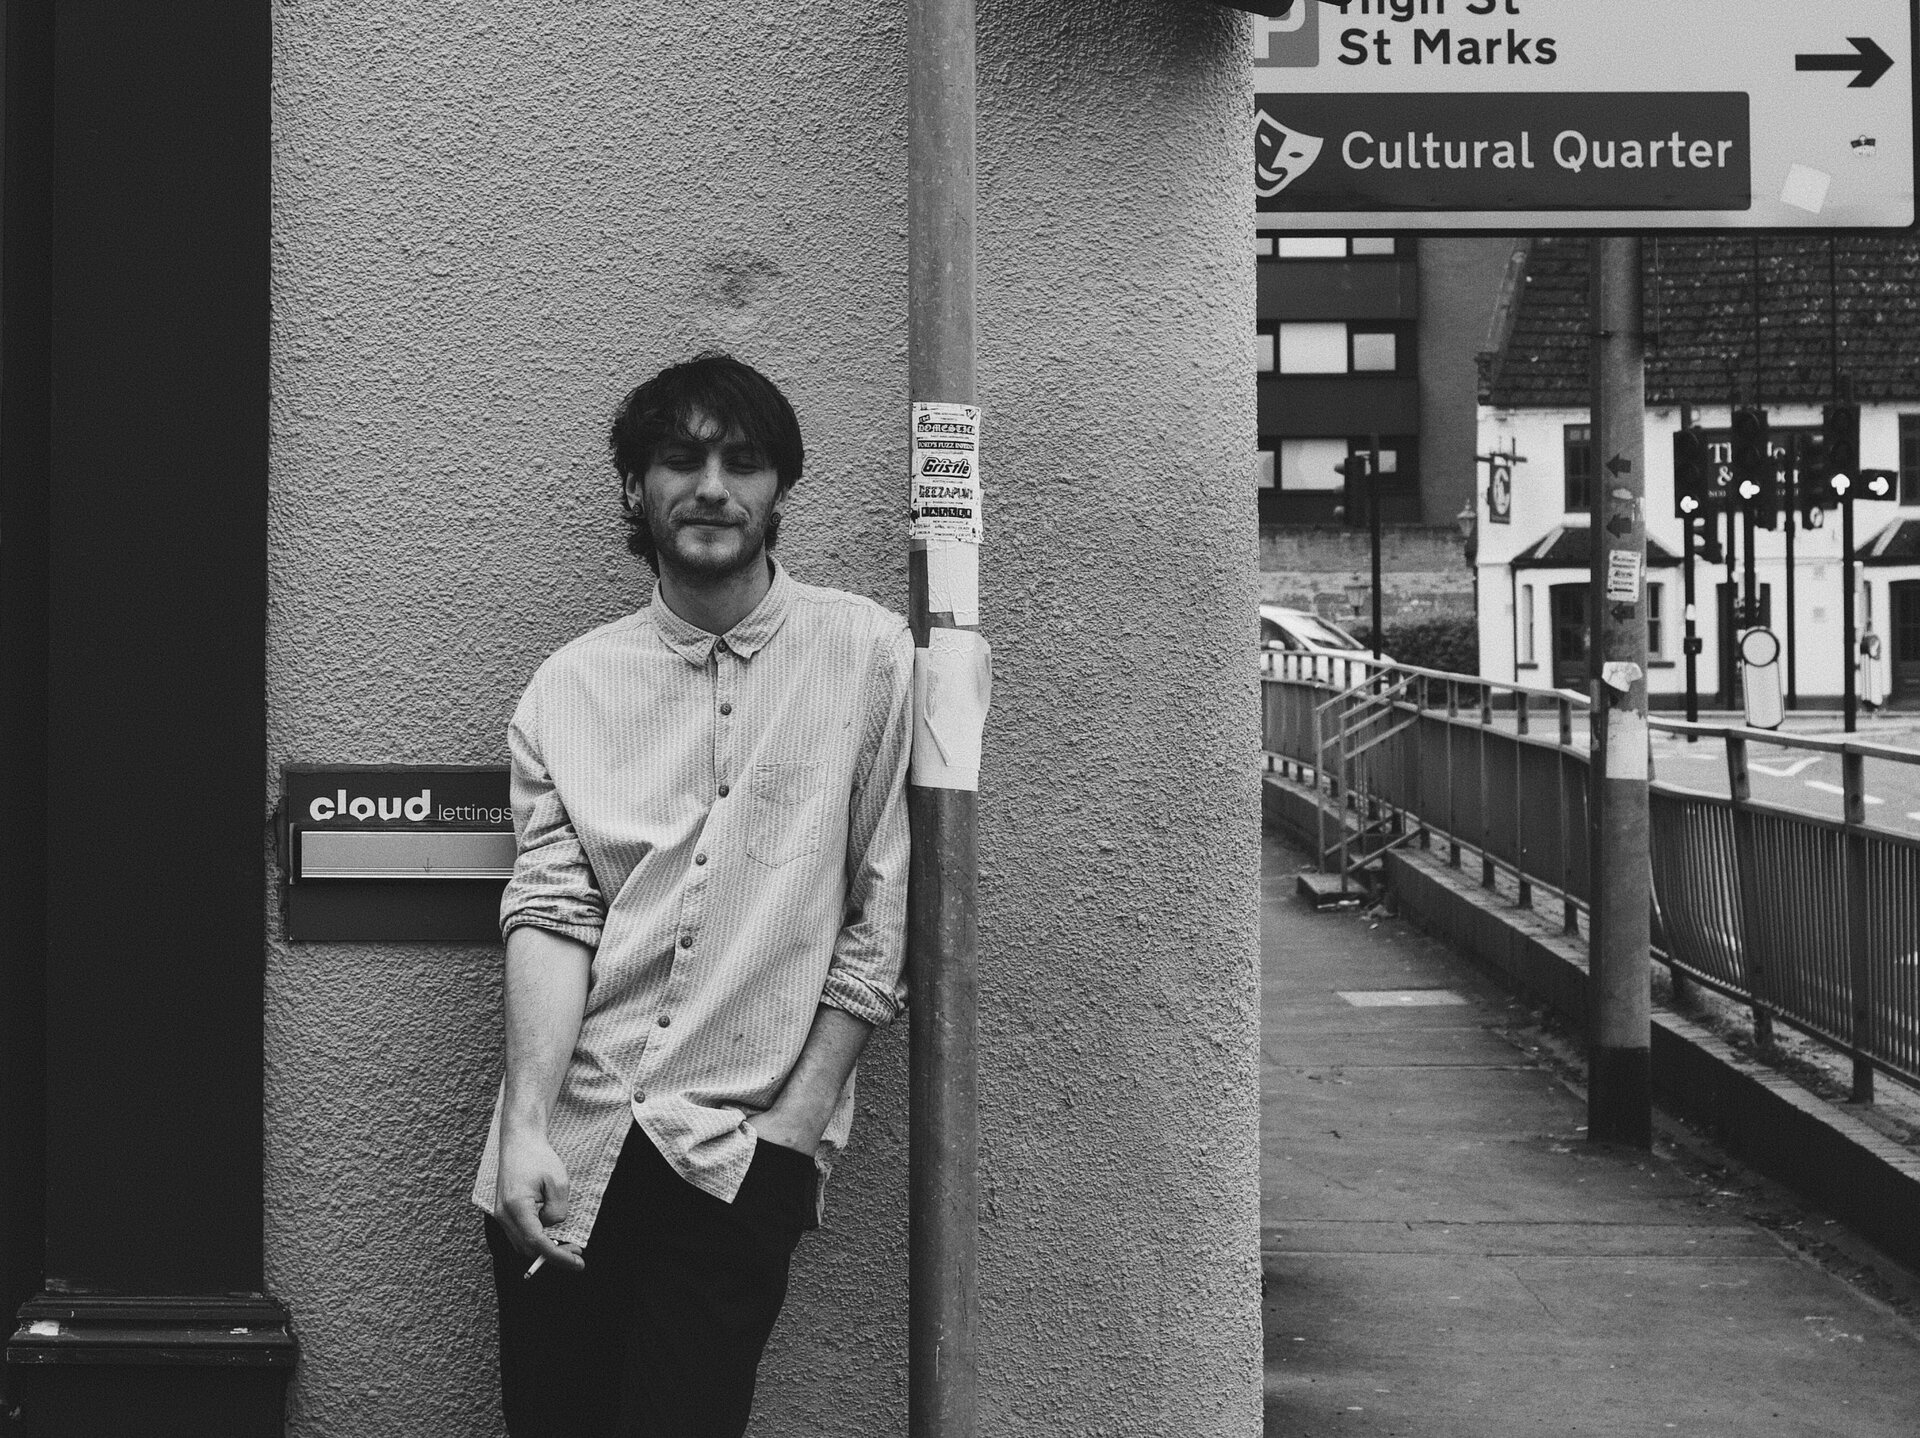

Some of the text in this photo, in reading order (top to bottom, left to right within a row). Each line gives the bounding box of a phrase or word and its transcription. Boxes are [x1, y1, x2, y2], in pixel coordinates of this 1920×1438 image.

[1338, 28, 1557, 65] St Marks
[1342, 130, 1733, 173] Cultural Quarter
[922, 458, 971, 475] Gristle
[1717, 466, 1733, 486] &
[310, 789, 513, 823] cloud lettings
